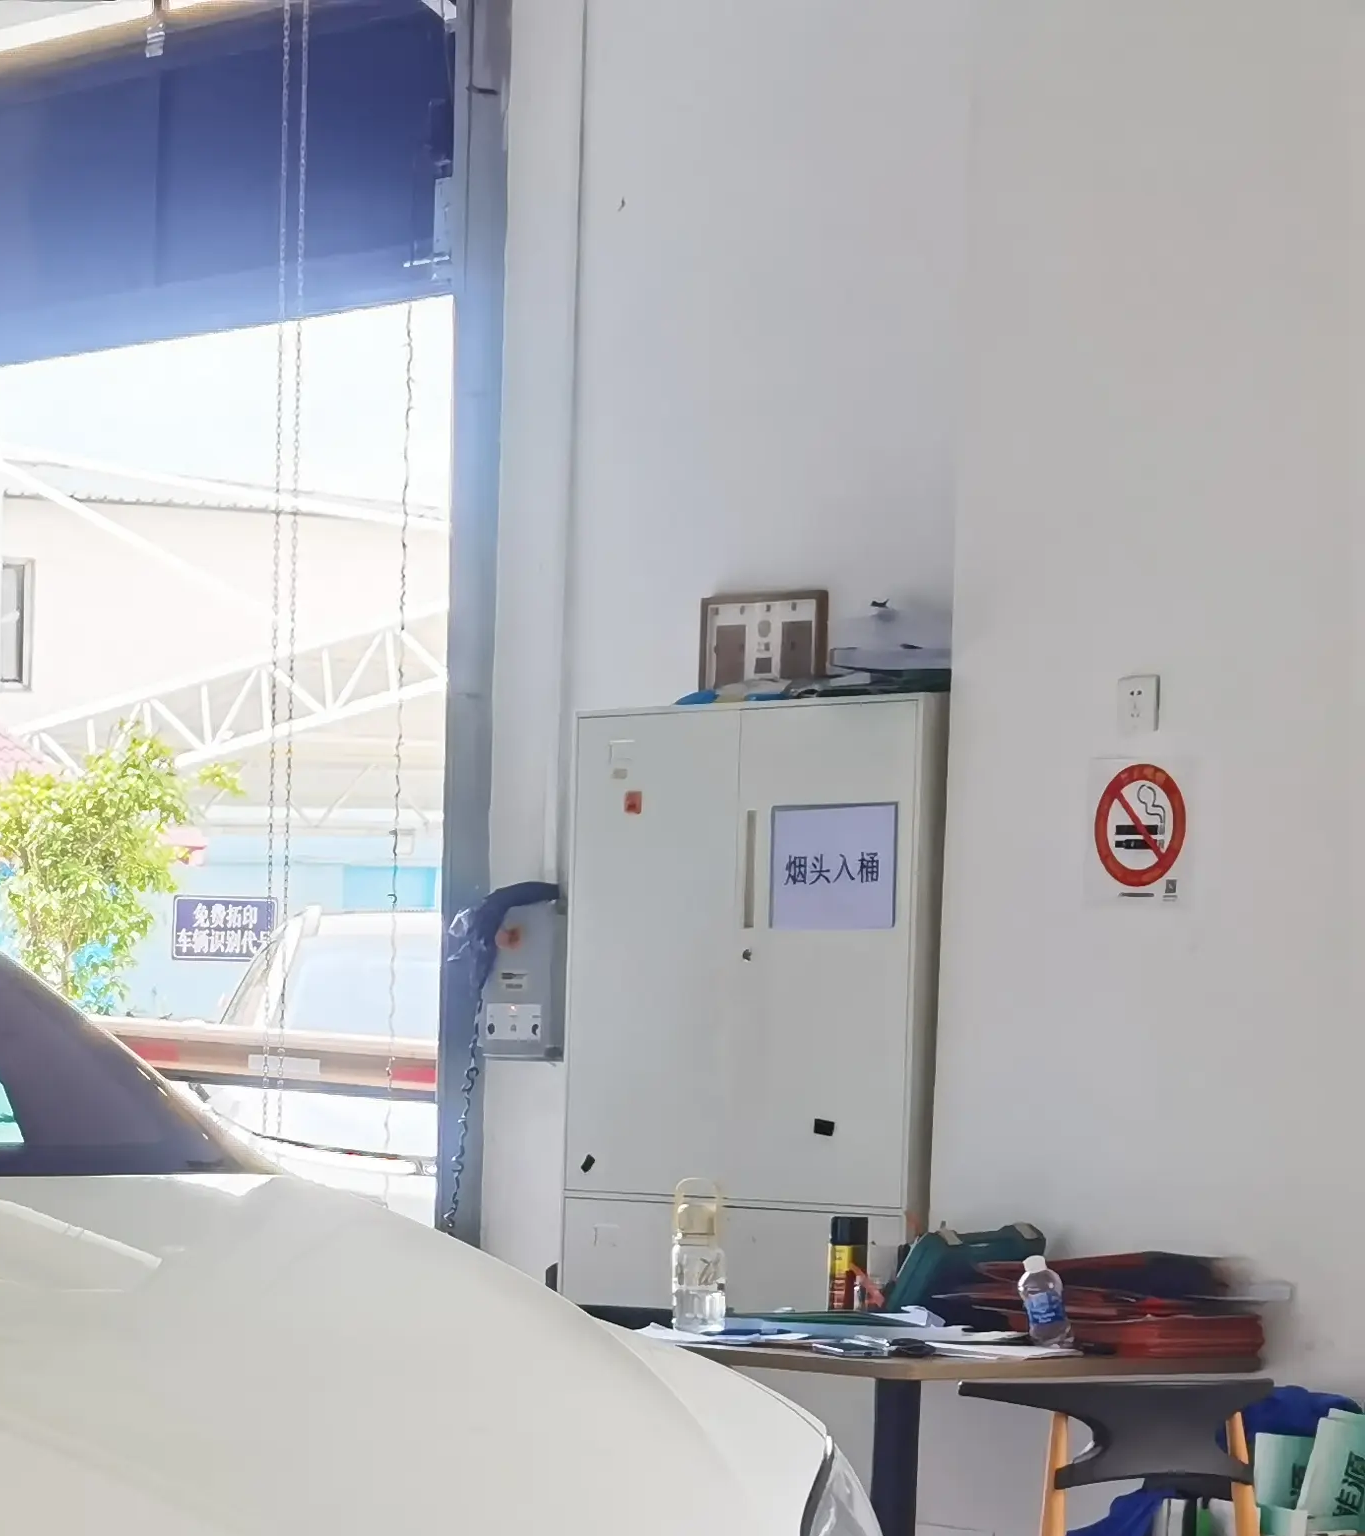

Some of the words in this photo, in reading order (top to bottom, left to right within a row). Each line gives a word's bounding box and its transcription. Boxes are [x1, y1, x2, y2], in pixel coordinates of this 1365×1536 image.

[784, 851, 880, 886] 烟头入桶
[191, 902, 259, 929] 免费拓印
